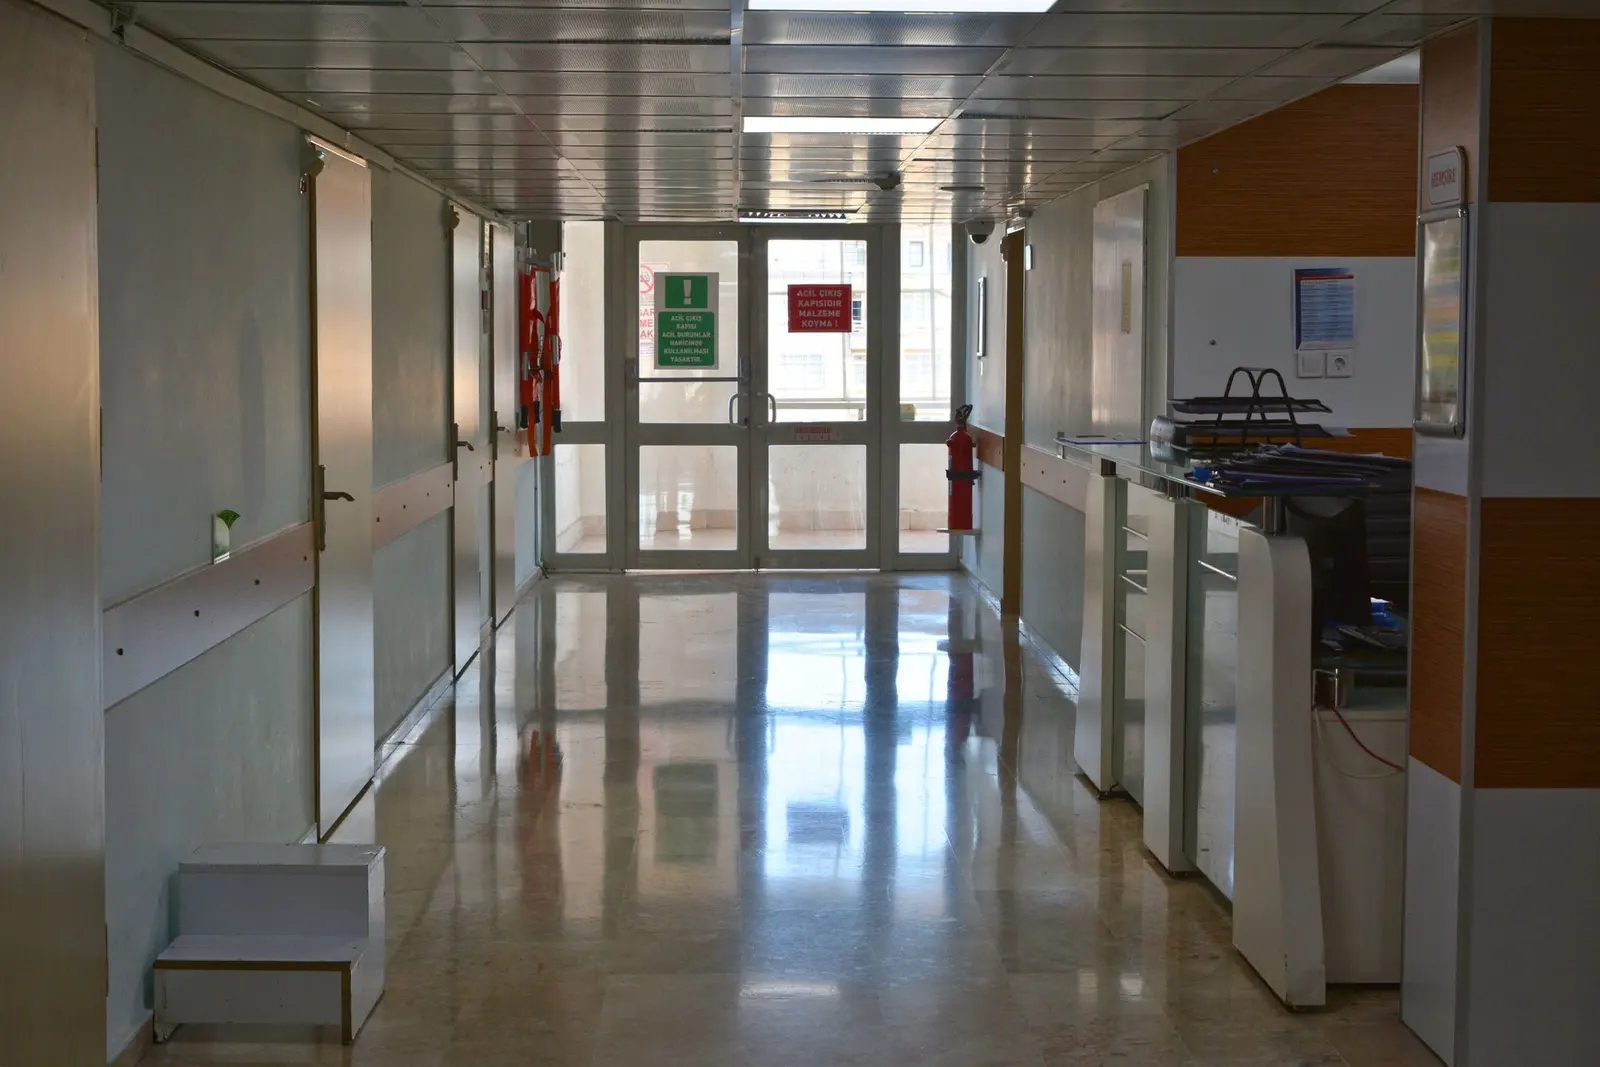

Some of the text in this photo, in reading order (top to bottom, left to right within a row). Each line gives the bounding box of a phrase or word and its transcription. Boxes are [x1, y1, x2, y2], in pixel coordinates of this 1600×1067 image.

[797, 288, 842, 298] ACİL ÇIKIŞ
[801, 320, 833, 328] KOYMA
